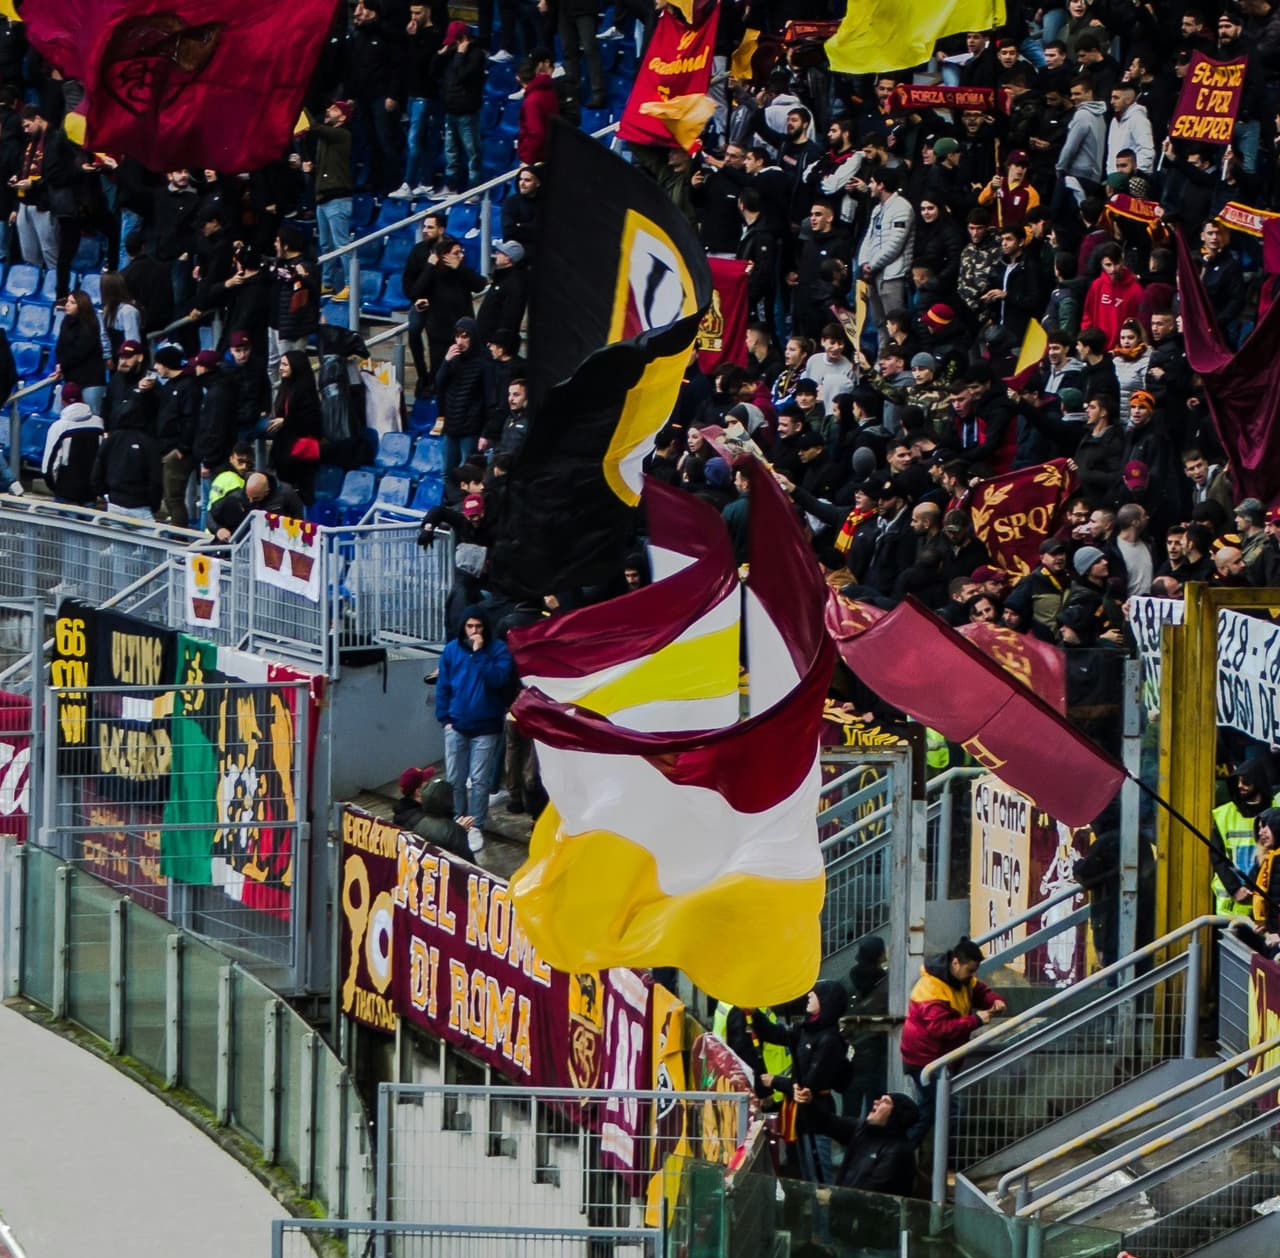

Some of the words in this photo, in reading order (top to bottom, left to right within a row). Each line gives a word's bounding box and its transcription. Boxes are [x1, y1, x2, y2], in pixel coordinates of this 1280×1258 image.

[1192, 62, 1243, 88] SEMPRE
[911, 87, 946, 104] FORZA
[955, 88, 985, 106] ROMA
[1196, 89, 1209, 110] E
[1211, 91, 1231, 112] PER
[1173, 115, 1233, 141] SEMPRE!
[55, 616, 87, 657] 66
[111, 629, 163, 686] ULTIMO
[975, 782, 991, 823] de
[992, 786, 1027, 833] roma
[393, 832, 456, 936] NEL
[991, 852, 1021, 896] mejo
[409, 934, 440, 1019] DI
[447, 957, 532, 1076] ROMA
